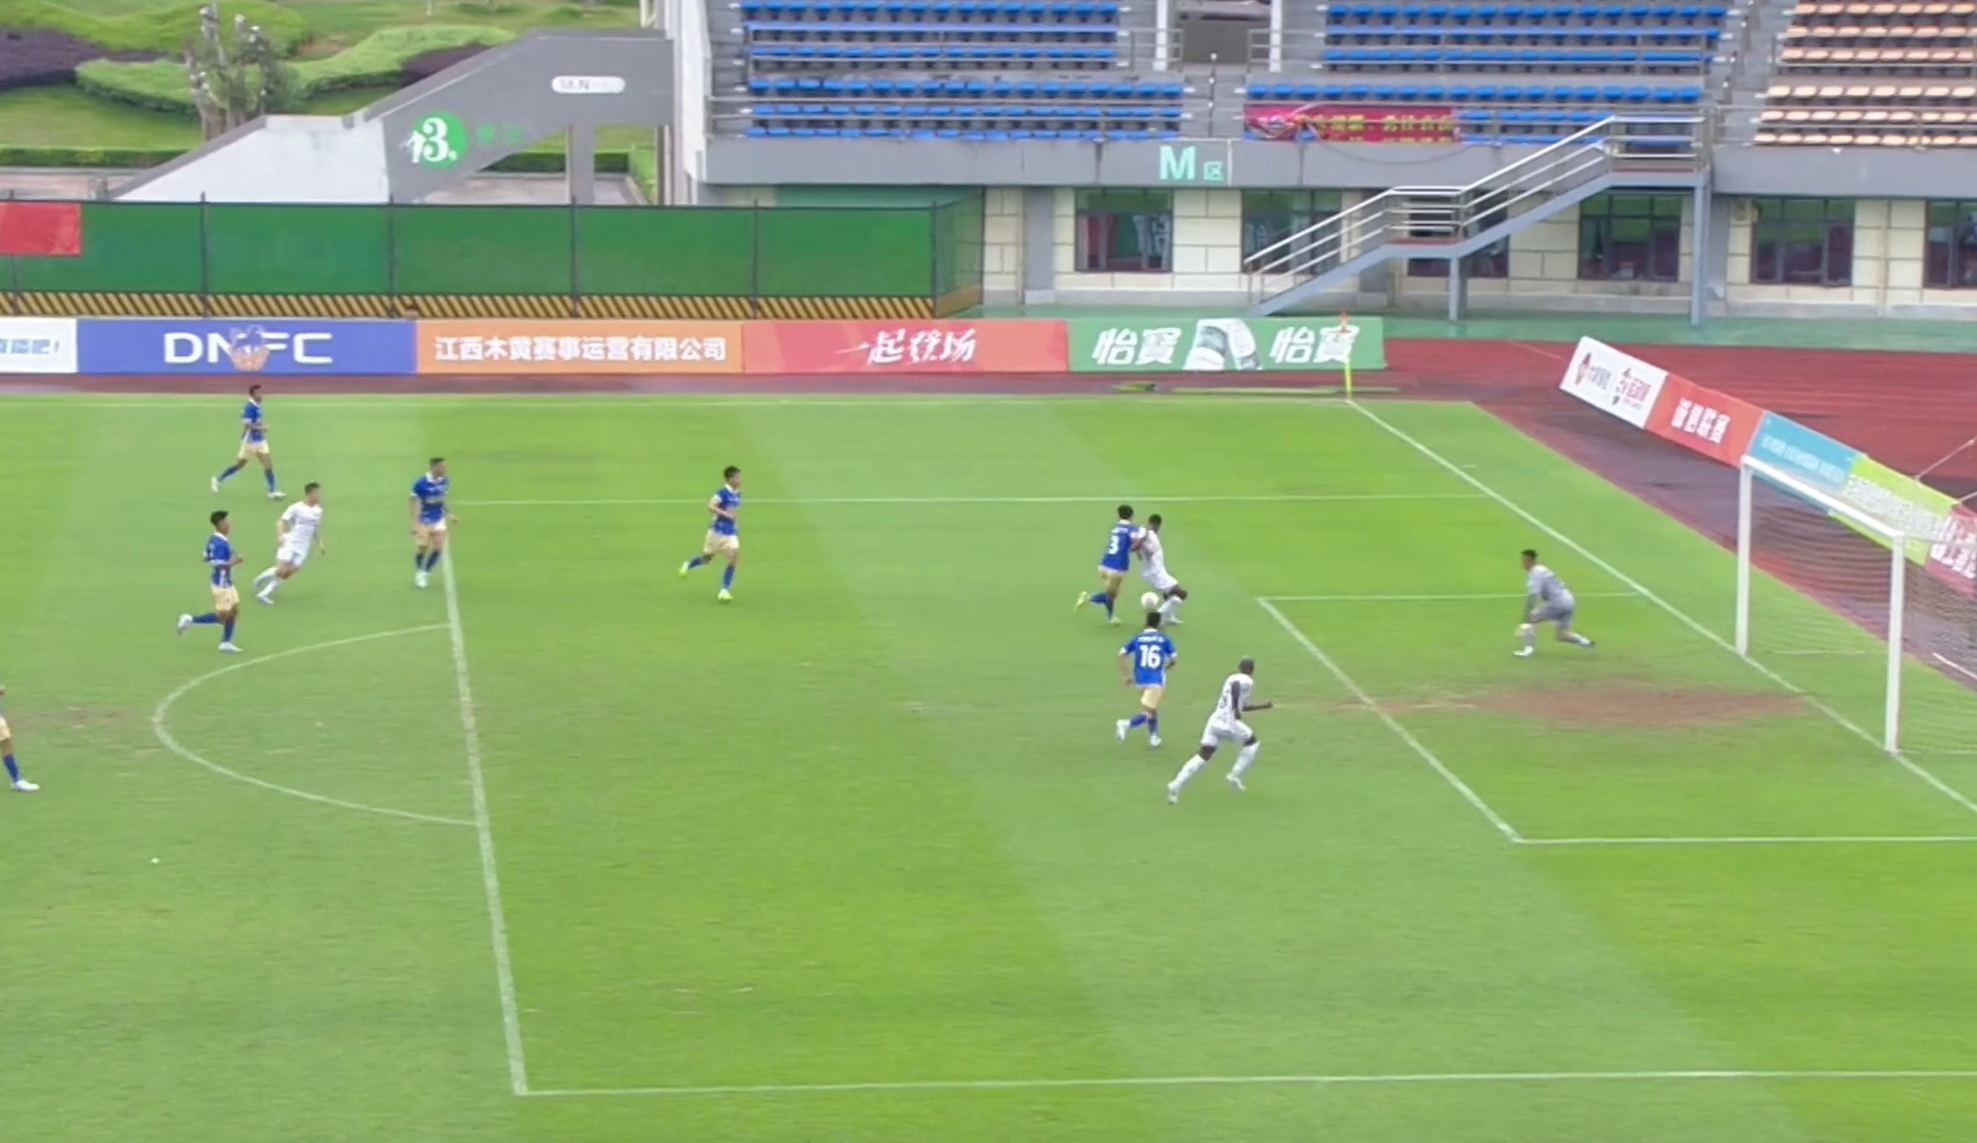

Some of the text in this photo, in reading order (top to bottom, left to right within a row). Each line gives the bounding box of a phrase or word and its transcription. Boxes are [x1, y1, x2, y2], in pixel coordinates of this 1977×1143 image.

[1159, 145, 1196, 180] M
[164, 332, 333, 364] DNFC
[435, 336, 726, 361] 江西木黄赛事运营有限公司
[1108, 535, 1119, 555] 3
[1139, 645, 1161, 668] 16
